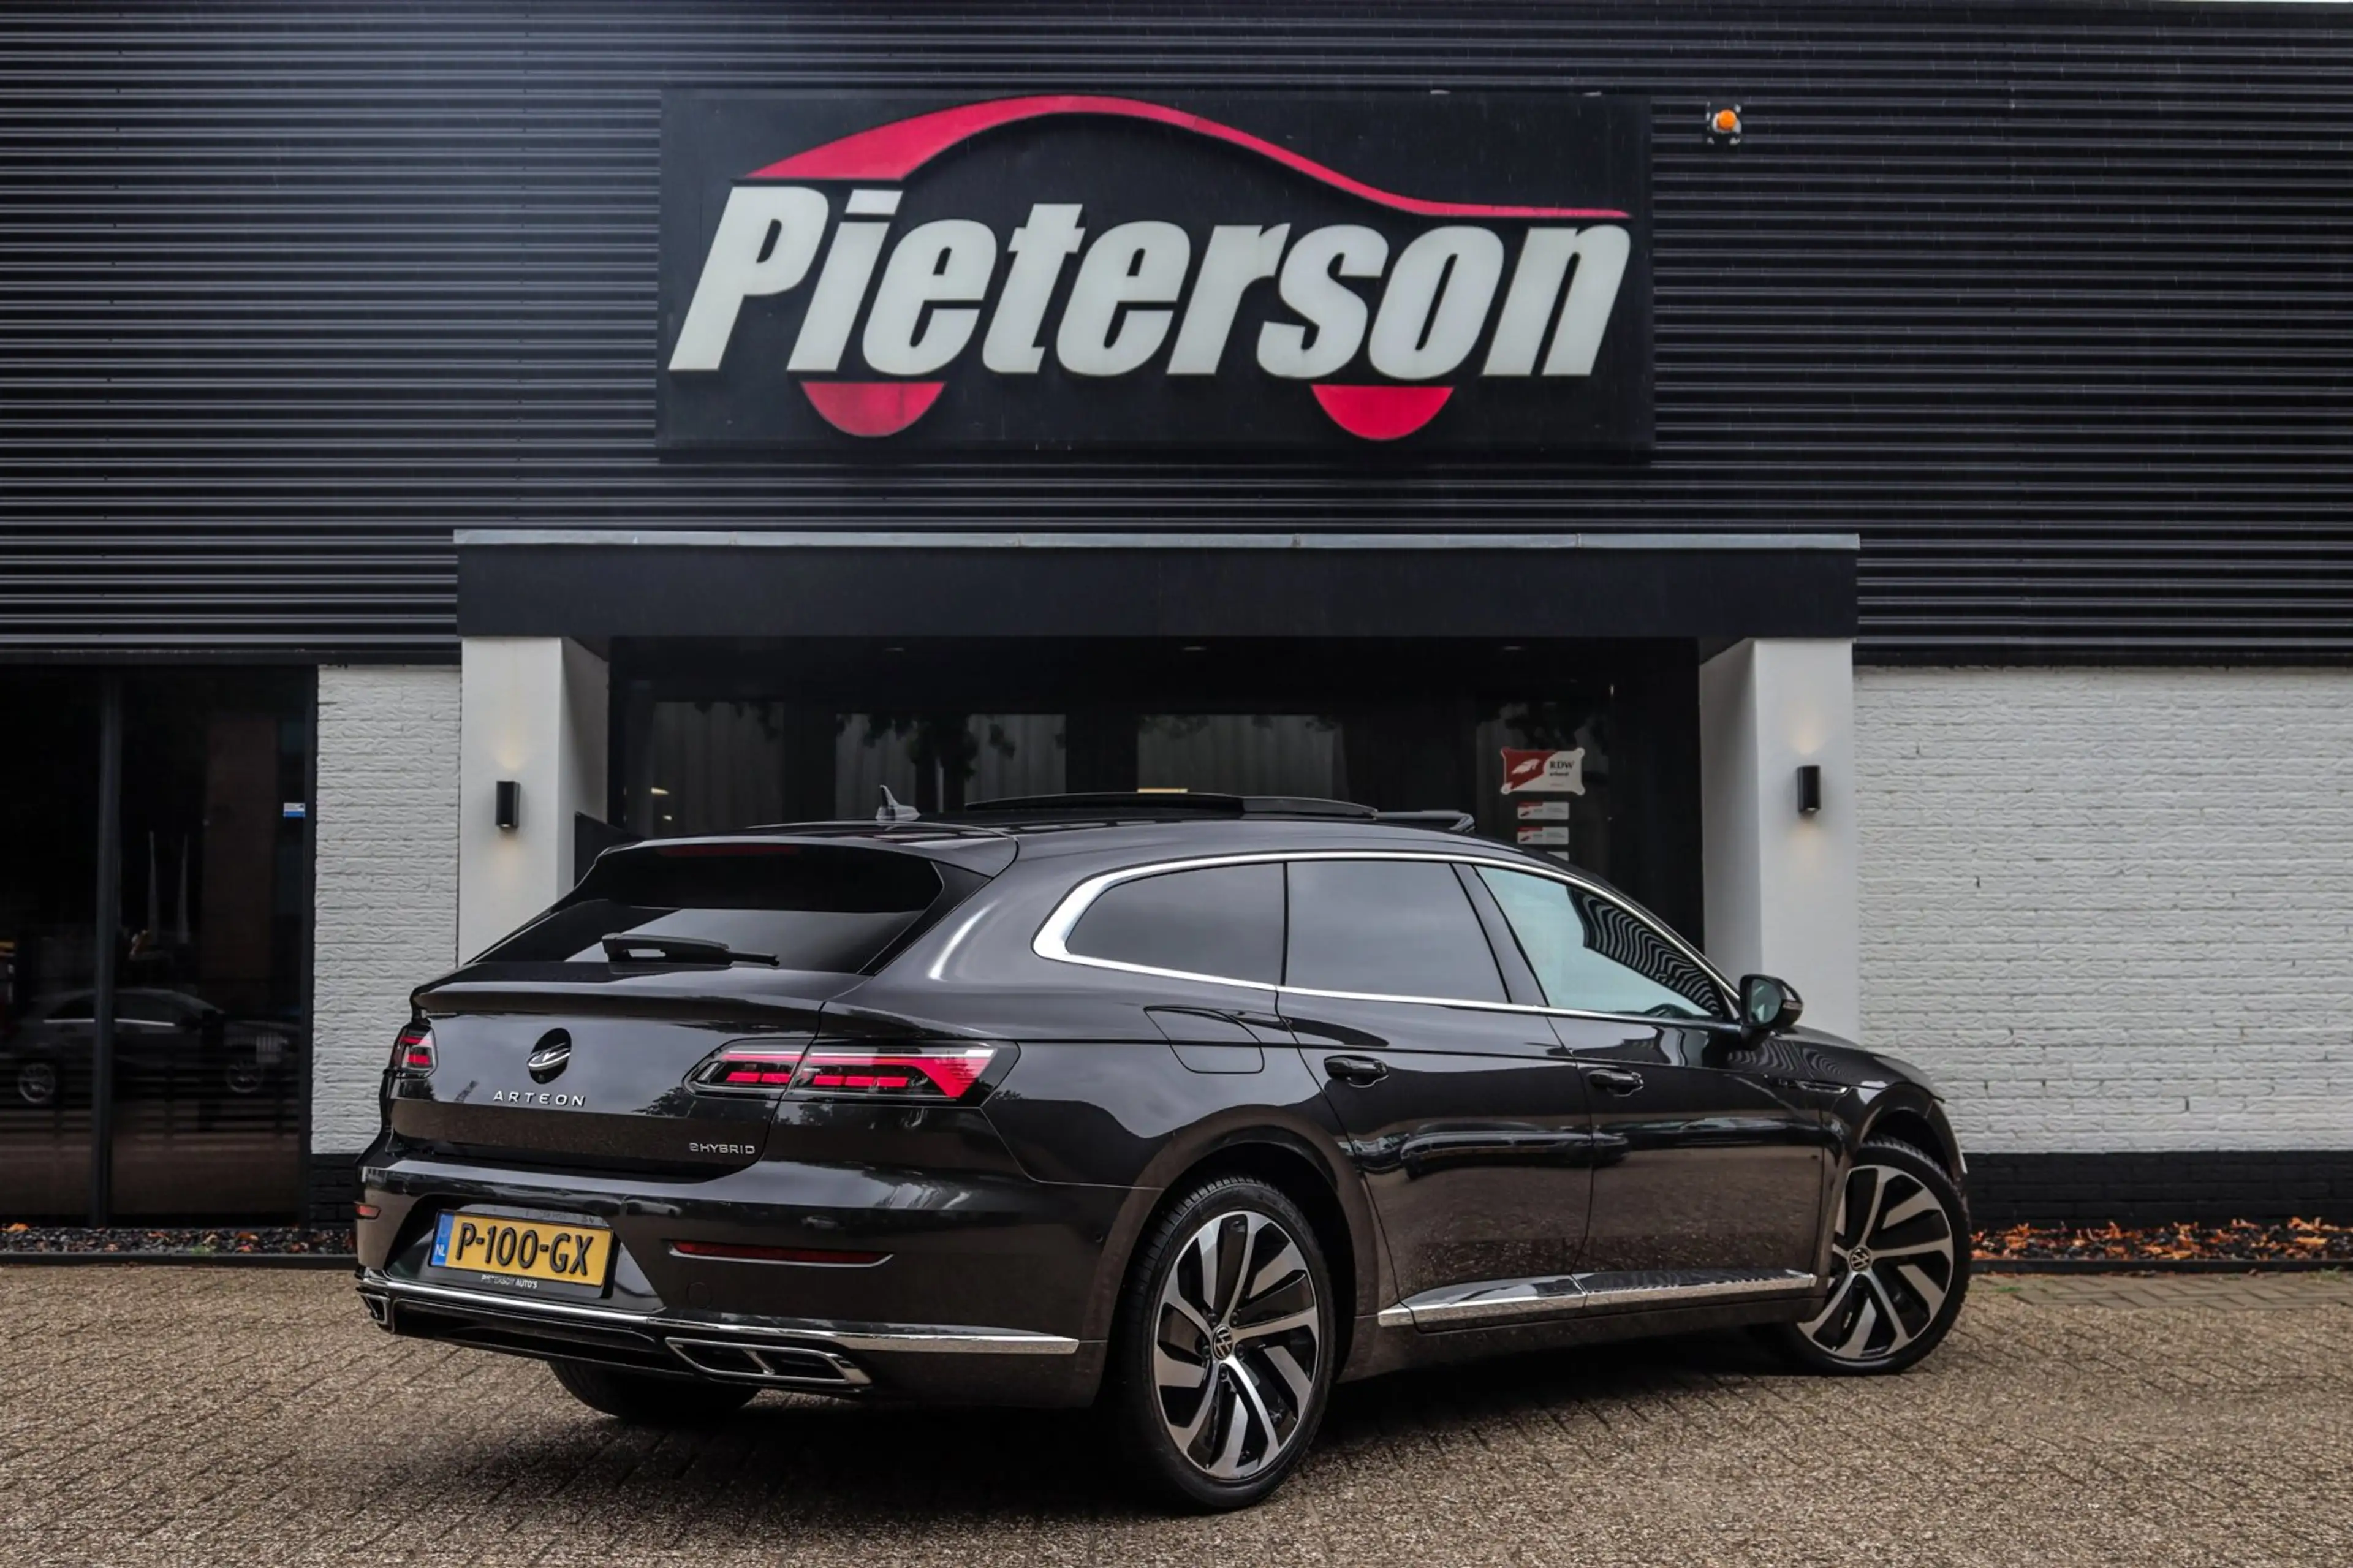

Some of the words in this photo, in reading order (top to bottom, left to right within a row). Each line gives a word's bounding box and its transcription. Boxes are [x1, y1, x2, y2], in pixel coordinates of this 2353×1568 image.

[667, 186, 1631, 381] Pieterson
[1550, 760, 1575, 770] RDW
[493, 1089, 586, 1107] ARTEON
[434, 1244, 446, 1257] NL
[456, 1222, 594, 1276] P-100-GX
